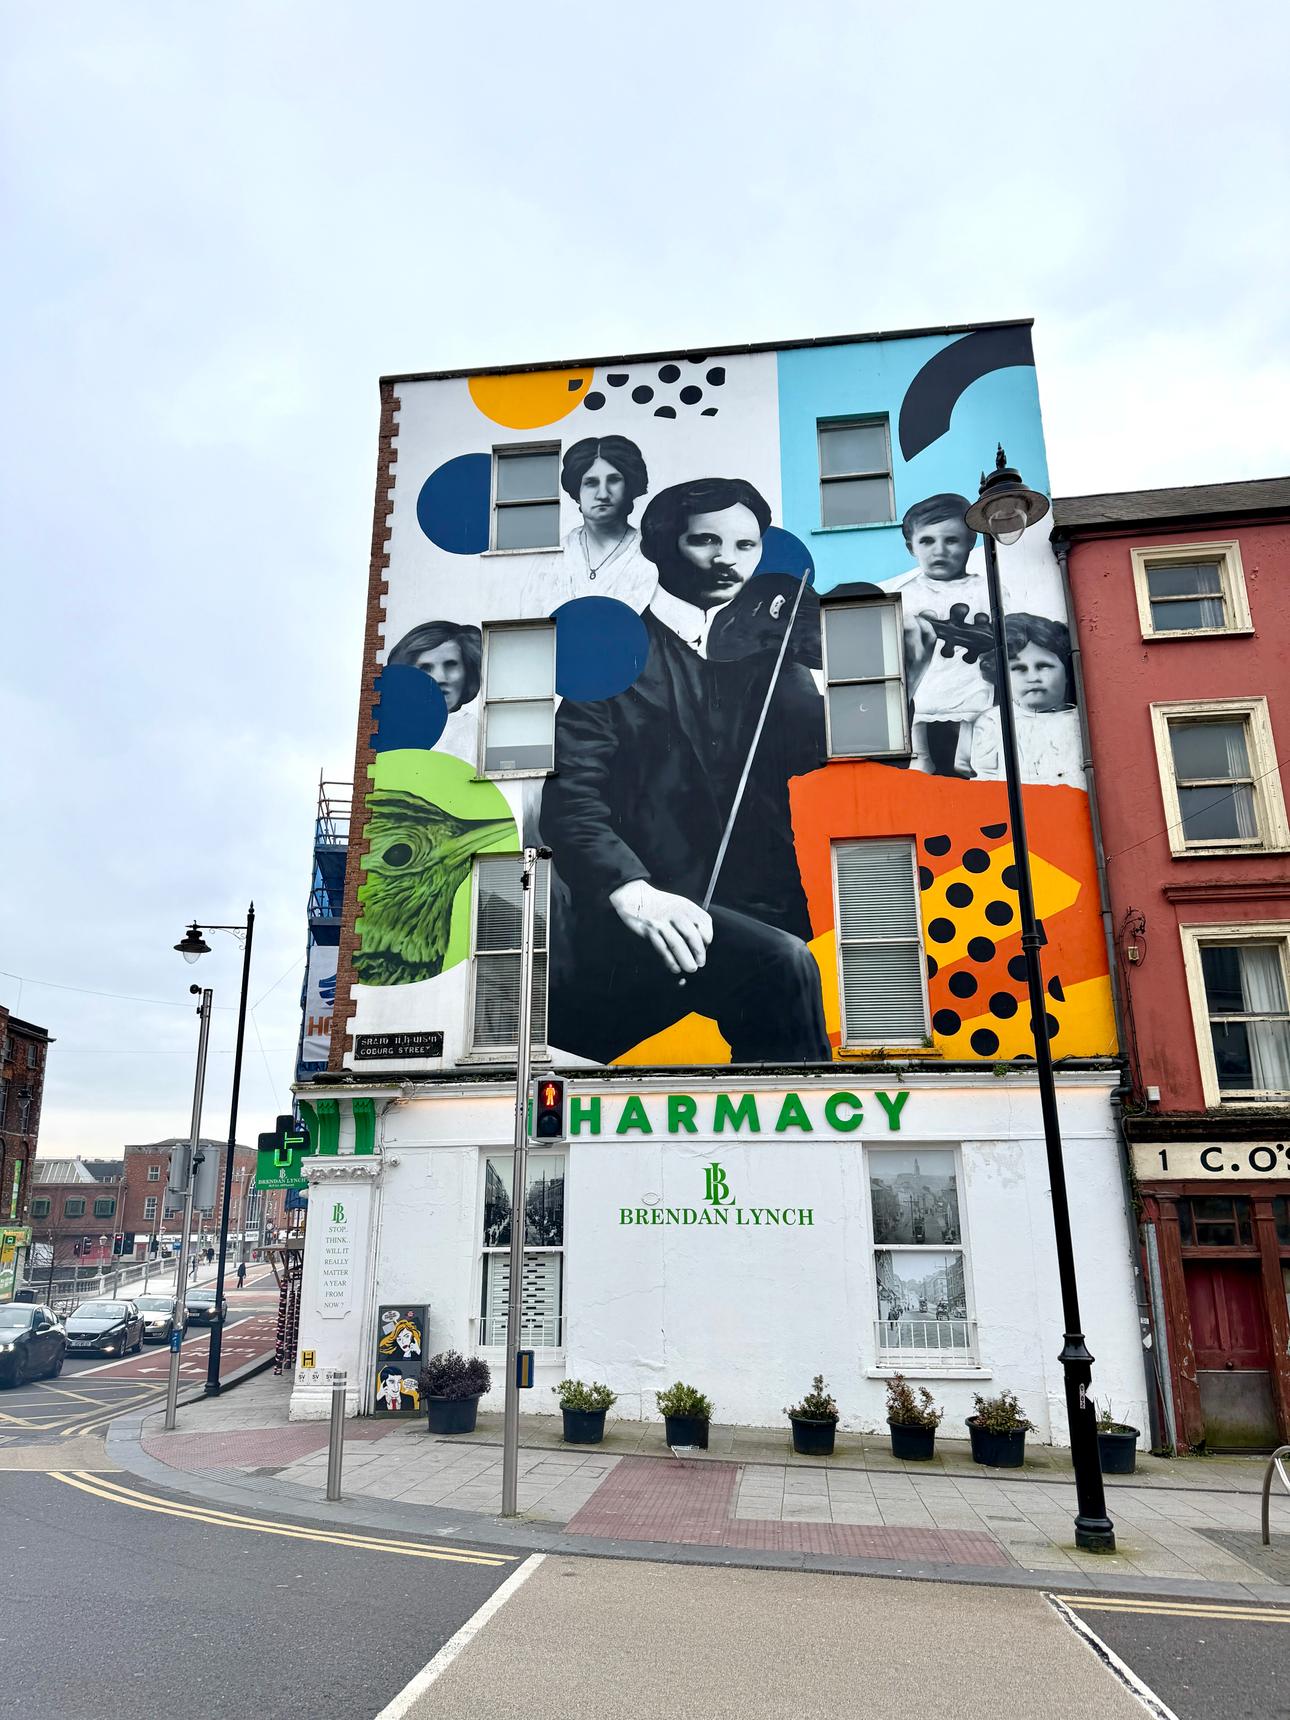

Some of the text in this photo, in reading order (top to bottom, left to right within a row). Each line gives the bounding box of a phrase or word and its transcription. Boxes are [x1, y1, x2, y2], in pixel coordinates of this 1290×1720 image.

[360, 1045, 431, 1055] COBURG STREET
[528, 1091, 910, 1136] HARMACY
[1158, 1143, 1290, 1172] 1 C.O'
[619, 1208, 815, 1226] BRENDAN LYNCH
